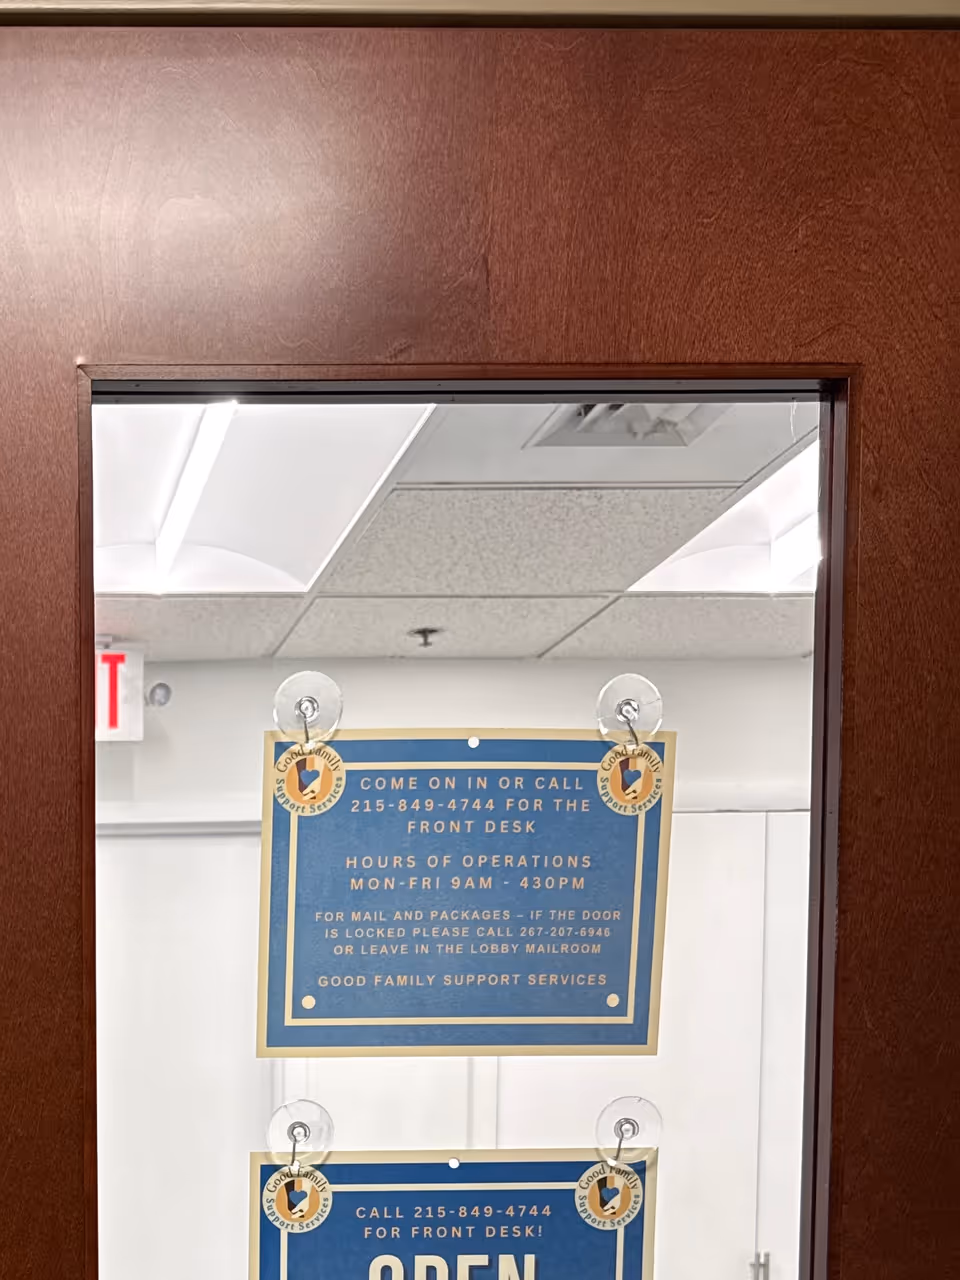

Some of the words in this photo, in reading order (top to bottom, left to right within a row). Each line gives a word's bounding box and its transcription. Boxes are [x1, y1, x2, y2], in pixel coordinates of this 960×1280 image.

[360, 777, 417, 790] COME
[429, 777, 455, 790] ON
[468, 776, 487, 790] IN
[499, 776, 523, 789] OR
[535, 777, 583, 790] CALL
[276, 778, 306, 814] Support
[600, 776, 627, 813] Support
[351, 798, 495, 812] 215-849-4744
[506, 798, 543, 811] FOR
[553, 799, 589, 812] THE
[408, 820, 474, 834] FRONT
[485, 820, 535, 833] DESK
[346, 856, 416, 868] HOURS
[427, 855, 452, 868] OF
[462, 855, 591, 868] OPERATIONS
[350, 877, 440, 890] MON-FRI
[450, 876, 492, 889] 9AM
[520, 876, 584, 889] 430PM
[315, 912, 344, 922] FOR
[351, 911, 387, 921] MAIL
[393, 911, 423, 920] AND
[430, 910, 510, 920] PACKAGES
[530, 910, 542, 920] IF
[549, 910, 575, 920] THE
[582, 910, 620, 920] DOOR
[325, 929, 338, 938] IS
[346, 928, 405, 938] LOCKED
[412, 927, 469, 938] PLEASE
[477, 927, 513, 936] CALL
[520, 927, 610, 937] 267-207-6946
[334, 945, 353, 955] OR
[361, 944, 408, 955] LEAVE
[415, 944, 429, 954] IN
[436, 944, 463, 954] THE
[471, 944, 519, 953] LOBBY
[525, 943, 601, 954] MAILROOM
[318, 976, 366, 987] GOOD
[374, 975, 435, 987] FAMILY
[444, 974, 521, 986] SUPPORT
[528, 974, 606, 985] SERVICES
[266, 1198, 295, 1231] Support
[356, 1207, 404, 1218] CALL
[414, 1205, 551, 1218] 215-849-4744
[578, 1194, 607, 1228] Support
[364, 1227, 400, 1239] FOR
[412, 1226, 475, 1238] FRONT
[485, 1225, 542, 1238] DESK!
